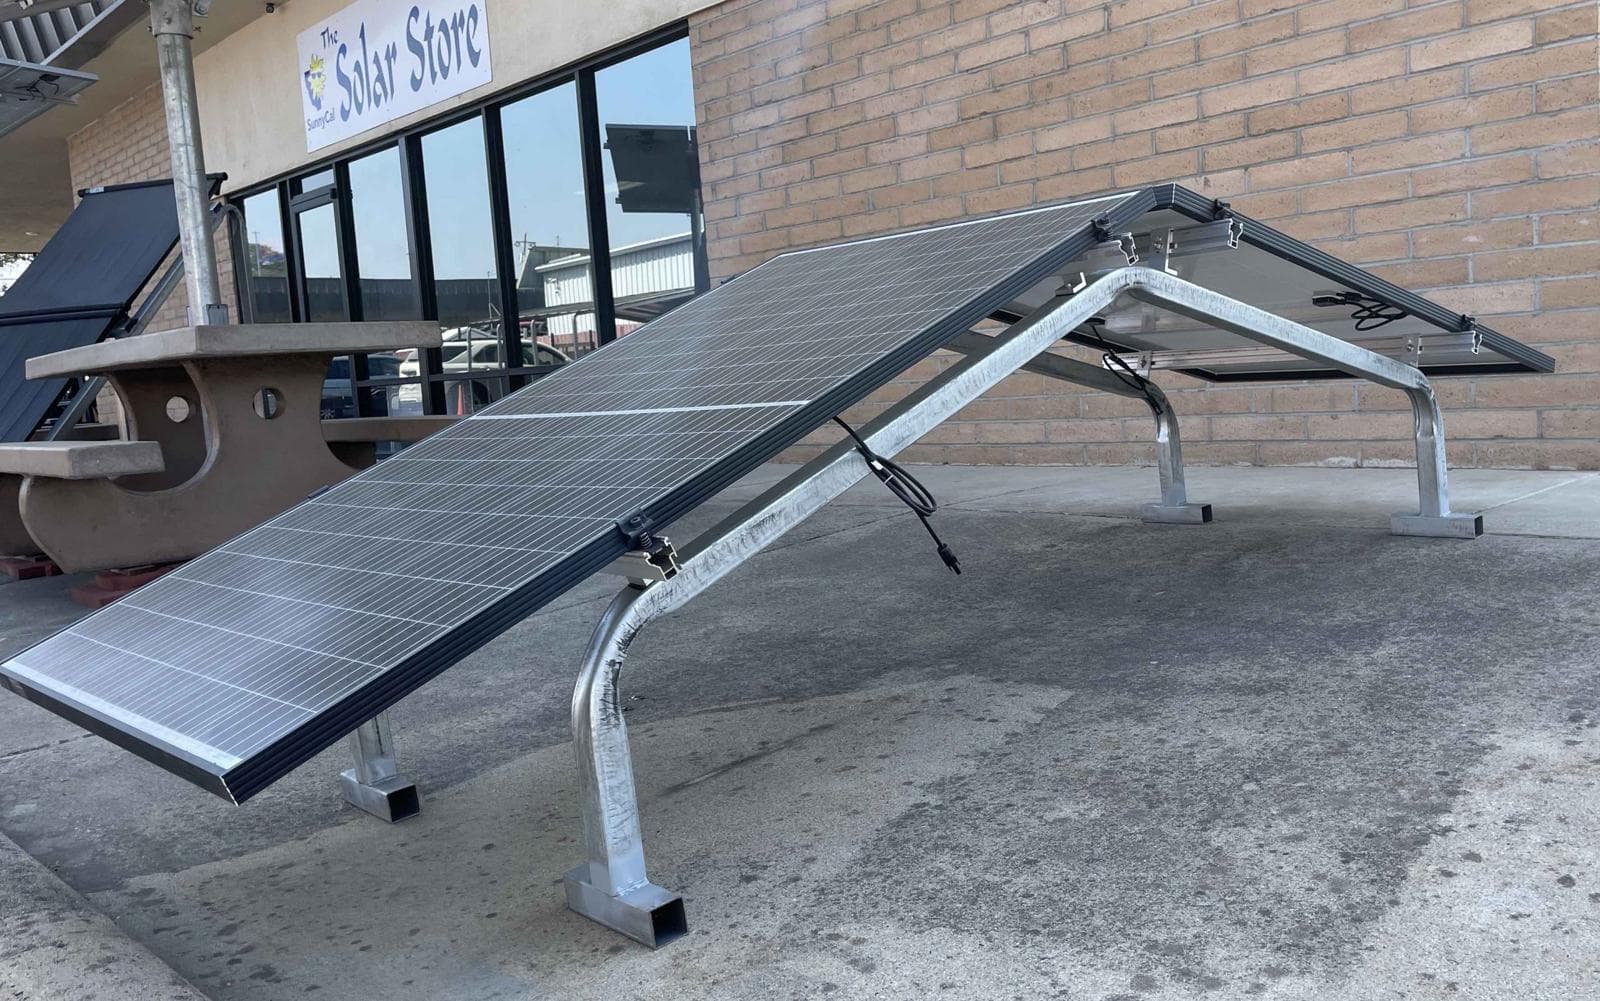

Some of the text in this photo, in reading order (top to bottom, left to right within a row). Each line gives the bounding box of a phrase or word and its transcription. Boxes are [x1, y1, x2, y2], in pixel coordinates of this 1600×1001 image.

[320, 27, 338, 49] The
[336, 4, 482, 122] Solar Store
[307, 108, 336, 131] SunnyCal
